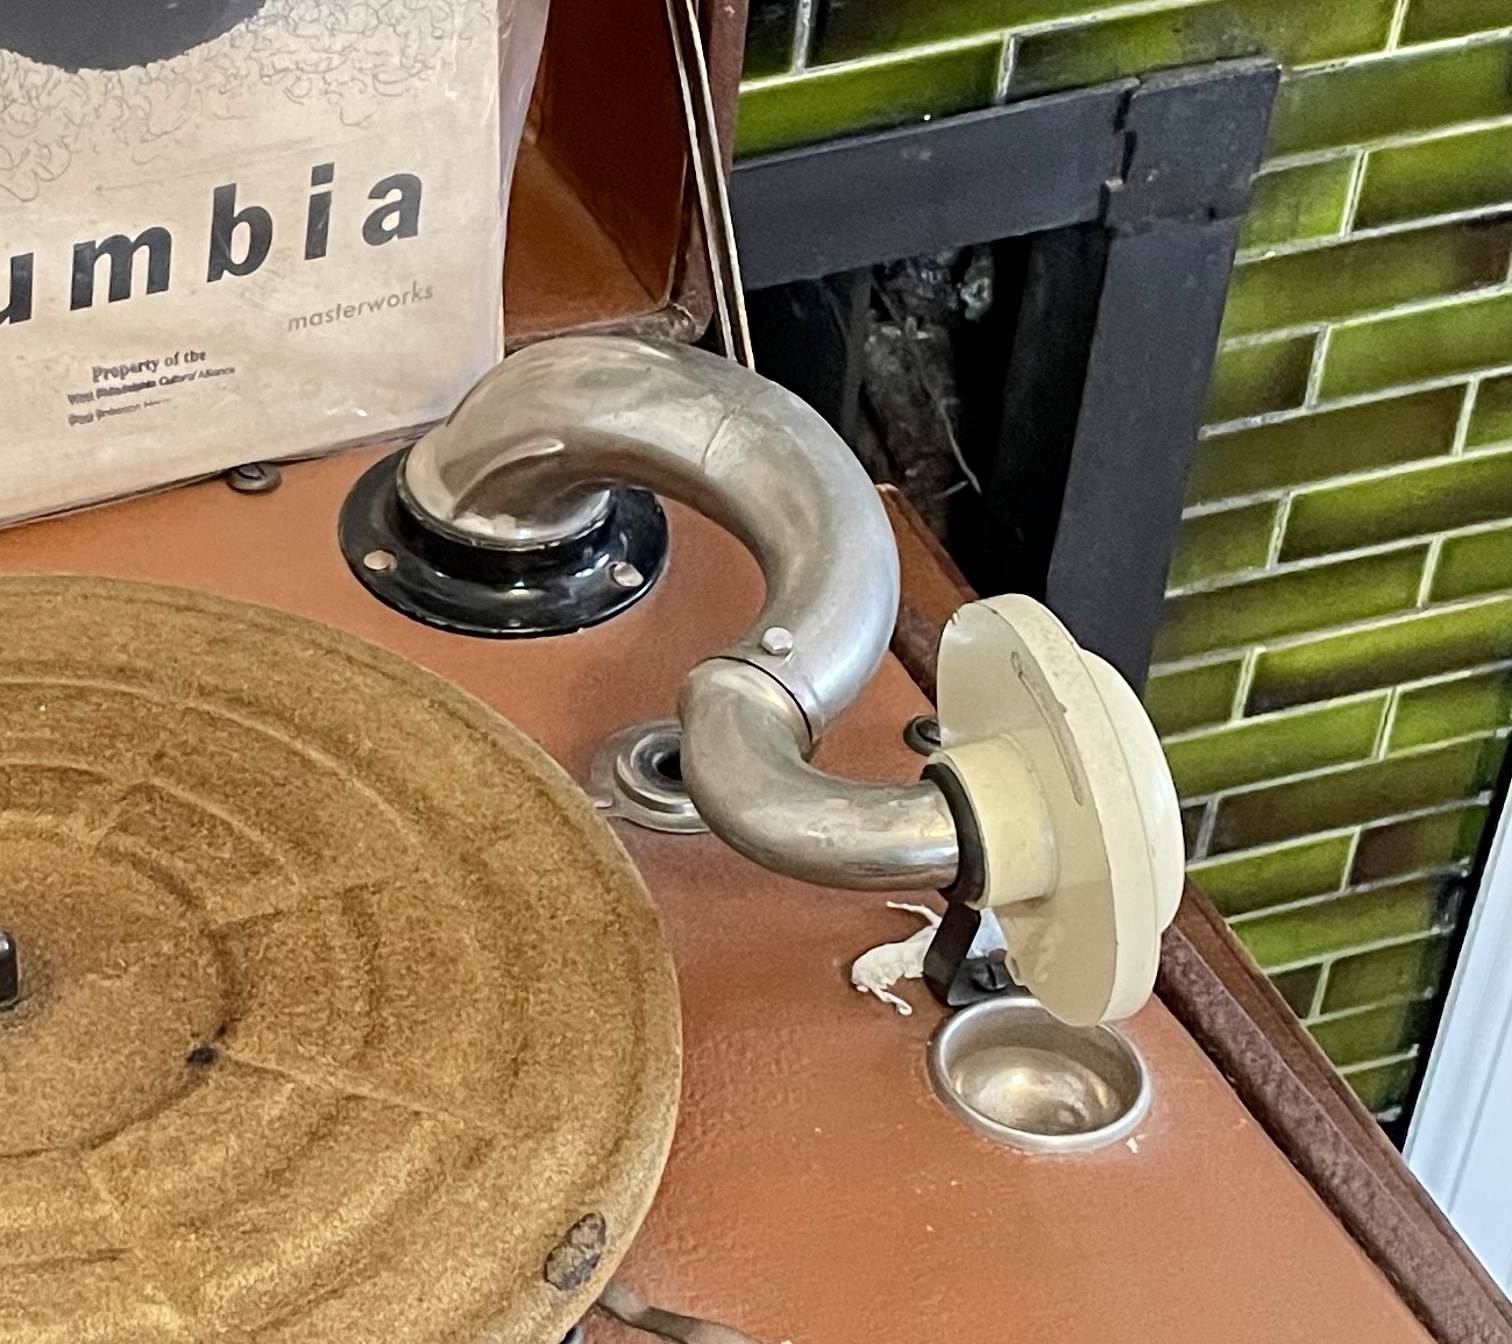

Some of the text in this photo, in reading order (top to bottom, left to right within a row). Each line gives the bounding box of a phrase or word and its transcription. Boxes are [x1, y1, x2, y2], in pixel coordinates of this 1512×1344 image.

[288, 281, 433, 331] masterworks
[92, 350, 206, 383] Property of the
